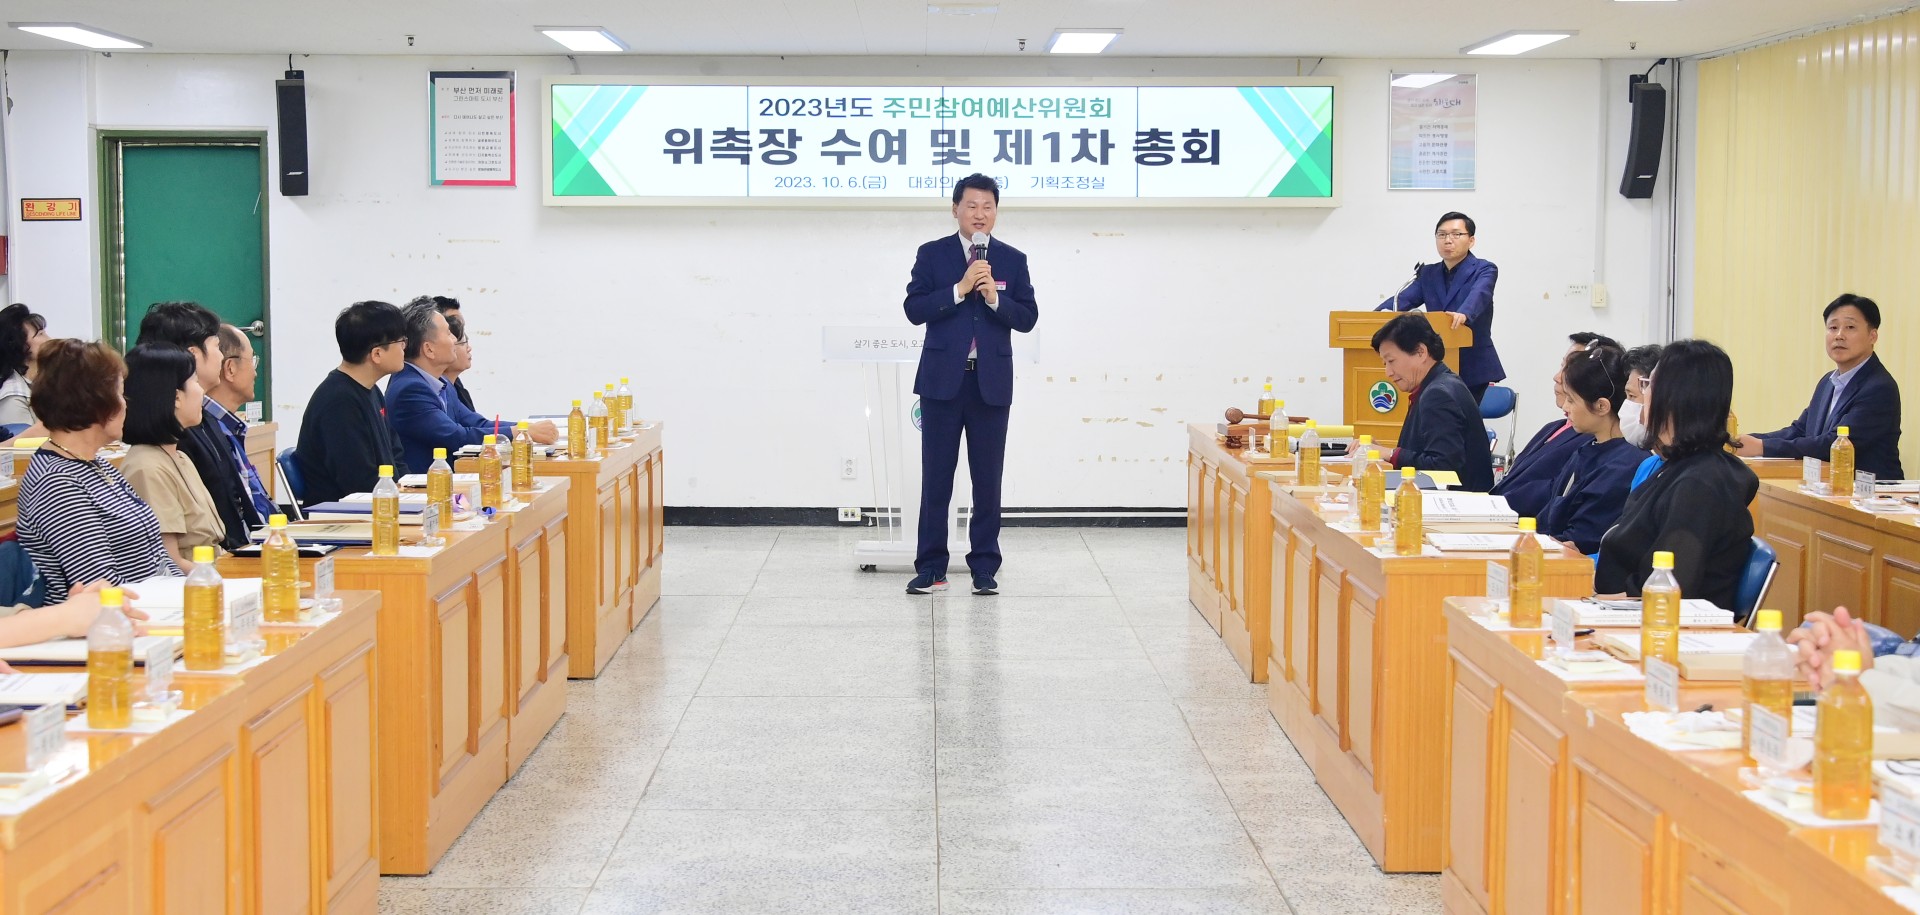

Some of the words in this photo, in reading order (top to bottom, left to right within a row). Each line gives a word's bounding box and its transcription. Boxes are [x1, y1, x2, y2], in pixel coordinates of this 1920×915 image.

[759, 97, 874, 119] 2023년도
[882, 97, 1112, 119] 주민참여예산위원회
[662, 126, 803, 166] 위촉장
[820, 128, 907, 166] 수여
[930, 128, 972, 166] 및
[992, 127, 1116, 166] 제1차
[1132, 127, 1221, 167] 총회
[774, 176, 816, 188] 2023.
[822, 176, 843, 188] 10.
[848, 175, 887, 190] 6.(금)
[1031, 175, 1105, 190] 기획조정실
[854, 339, 870, 349] 살기
[872, 339, 888, 349] 좋은
[890, 339, 909, 350] 도시,
